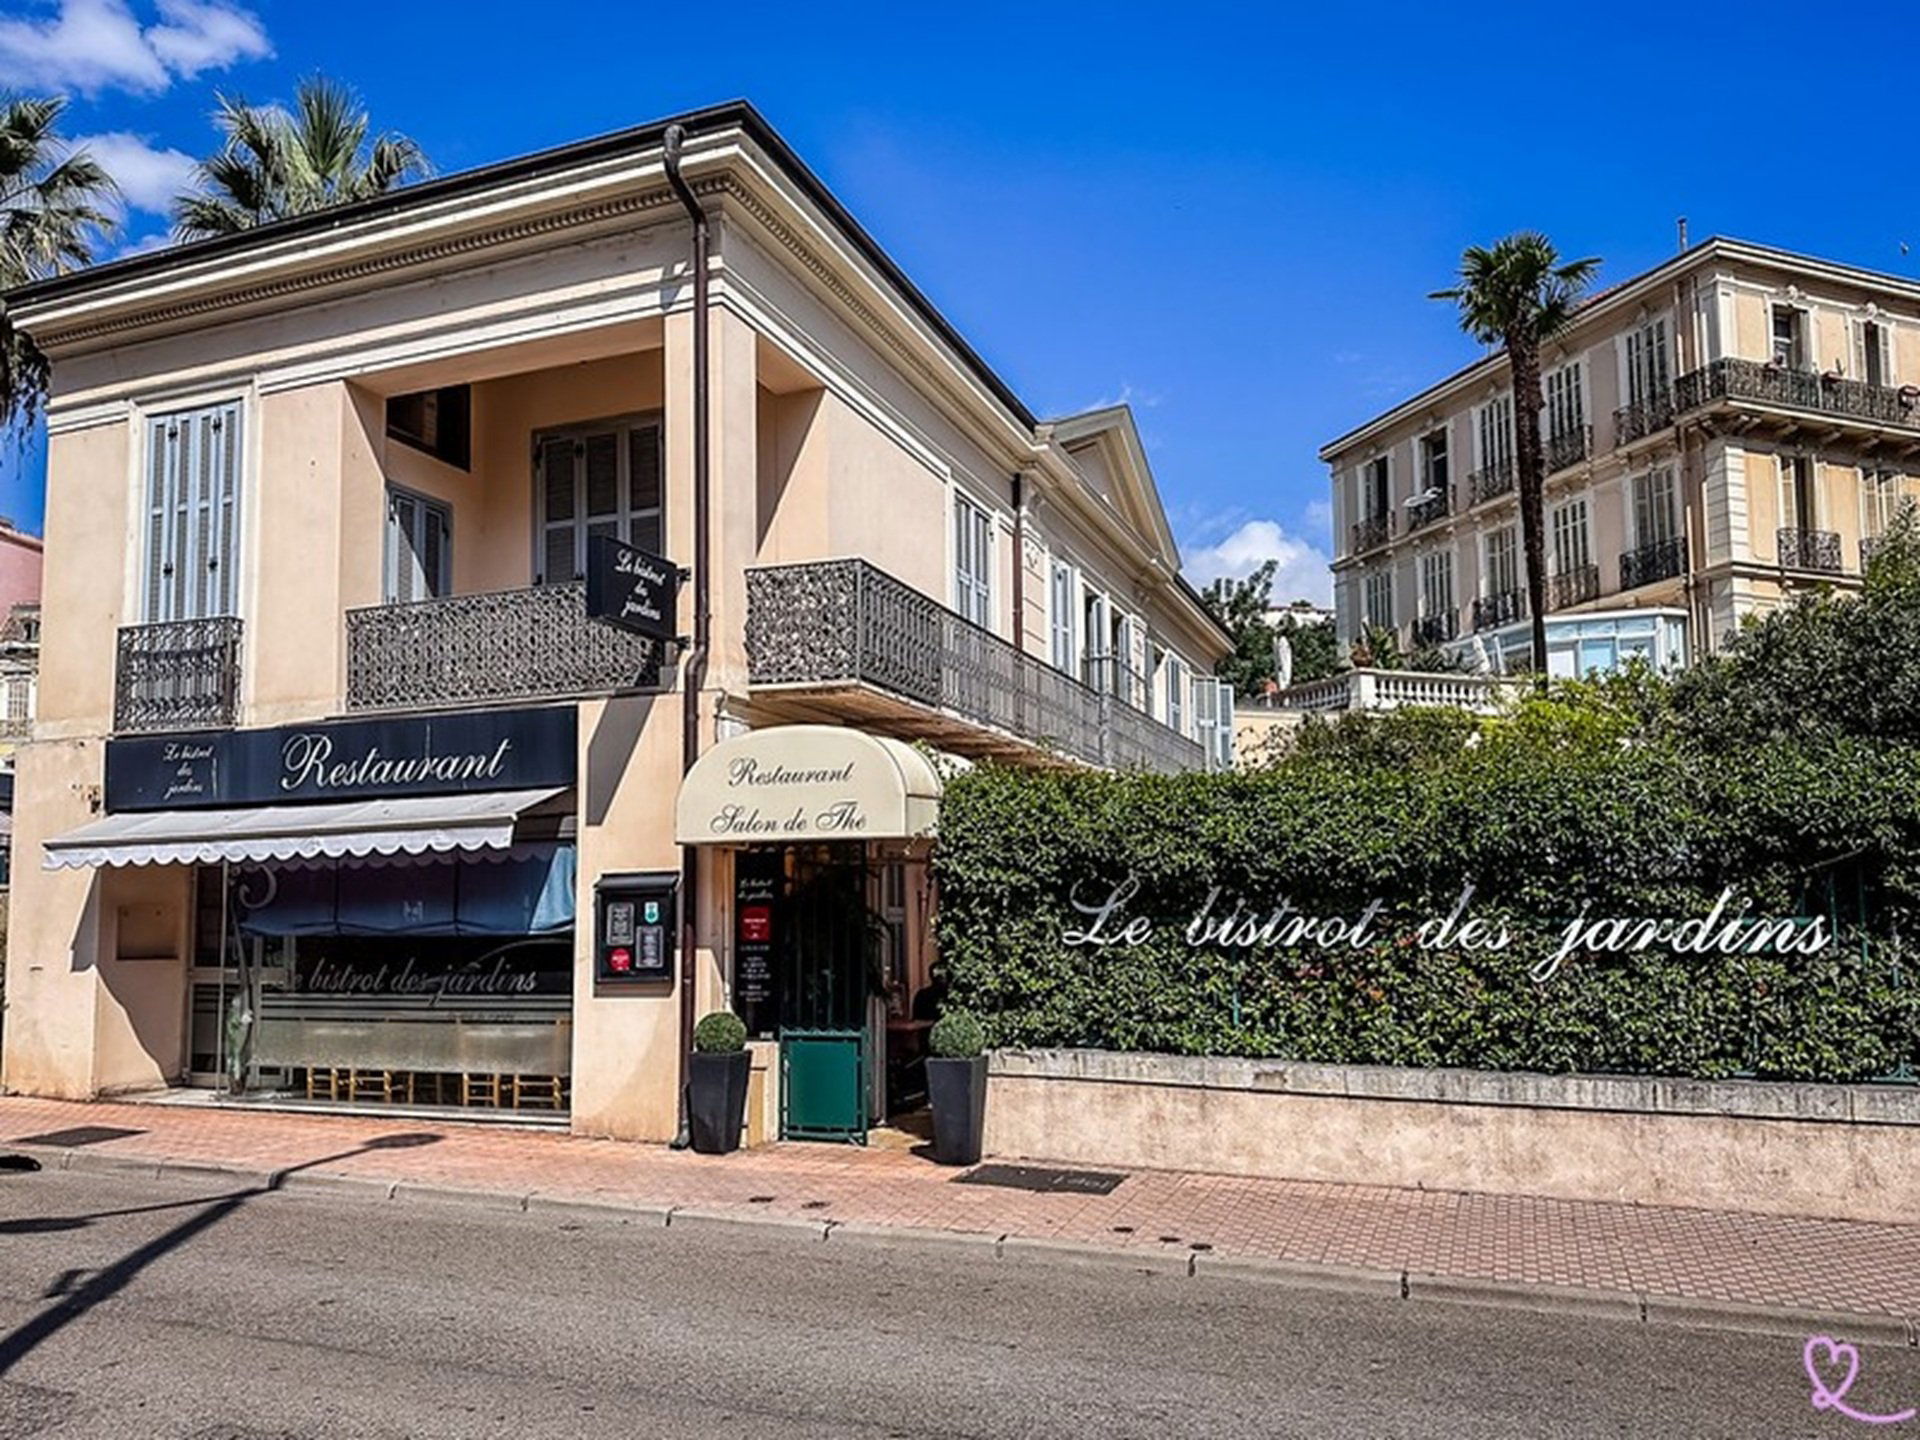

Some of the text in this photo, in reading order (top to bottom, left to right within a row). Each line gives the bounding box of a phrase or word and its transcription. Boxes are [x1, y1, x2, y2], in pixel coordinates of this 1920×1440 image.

[280, 733, 512, 790] Restaurant
[728, 757, 854, 787] Restaurant
[709, 803, 779, 834] Salon
[783, 806, 808, 832] de
[1062, 871, 1832, 983] Le bistrot des jardins
[308, 956, 387, 992] bistrot
[390, 956, 430, 993] des
[428, 956, 536, 1007] jardins
